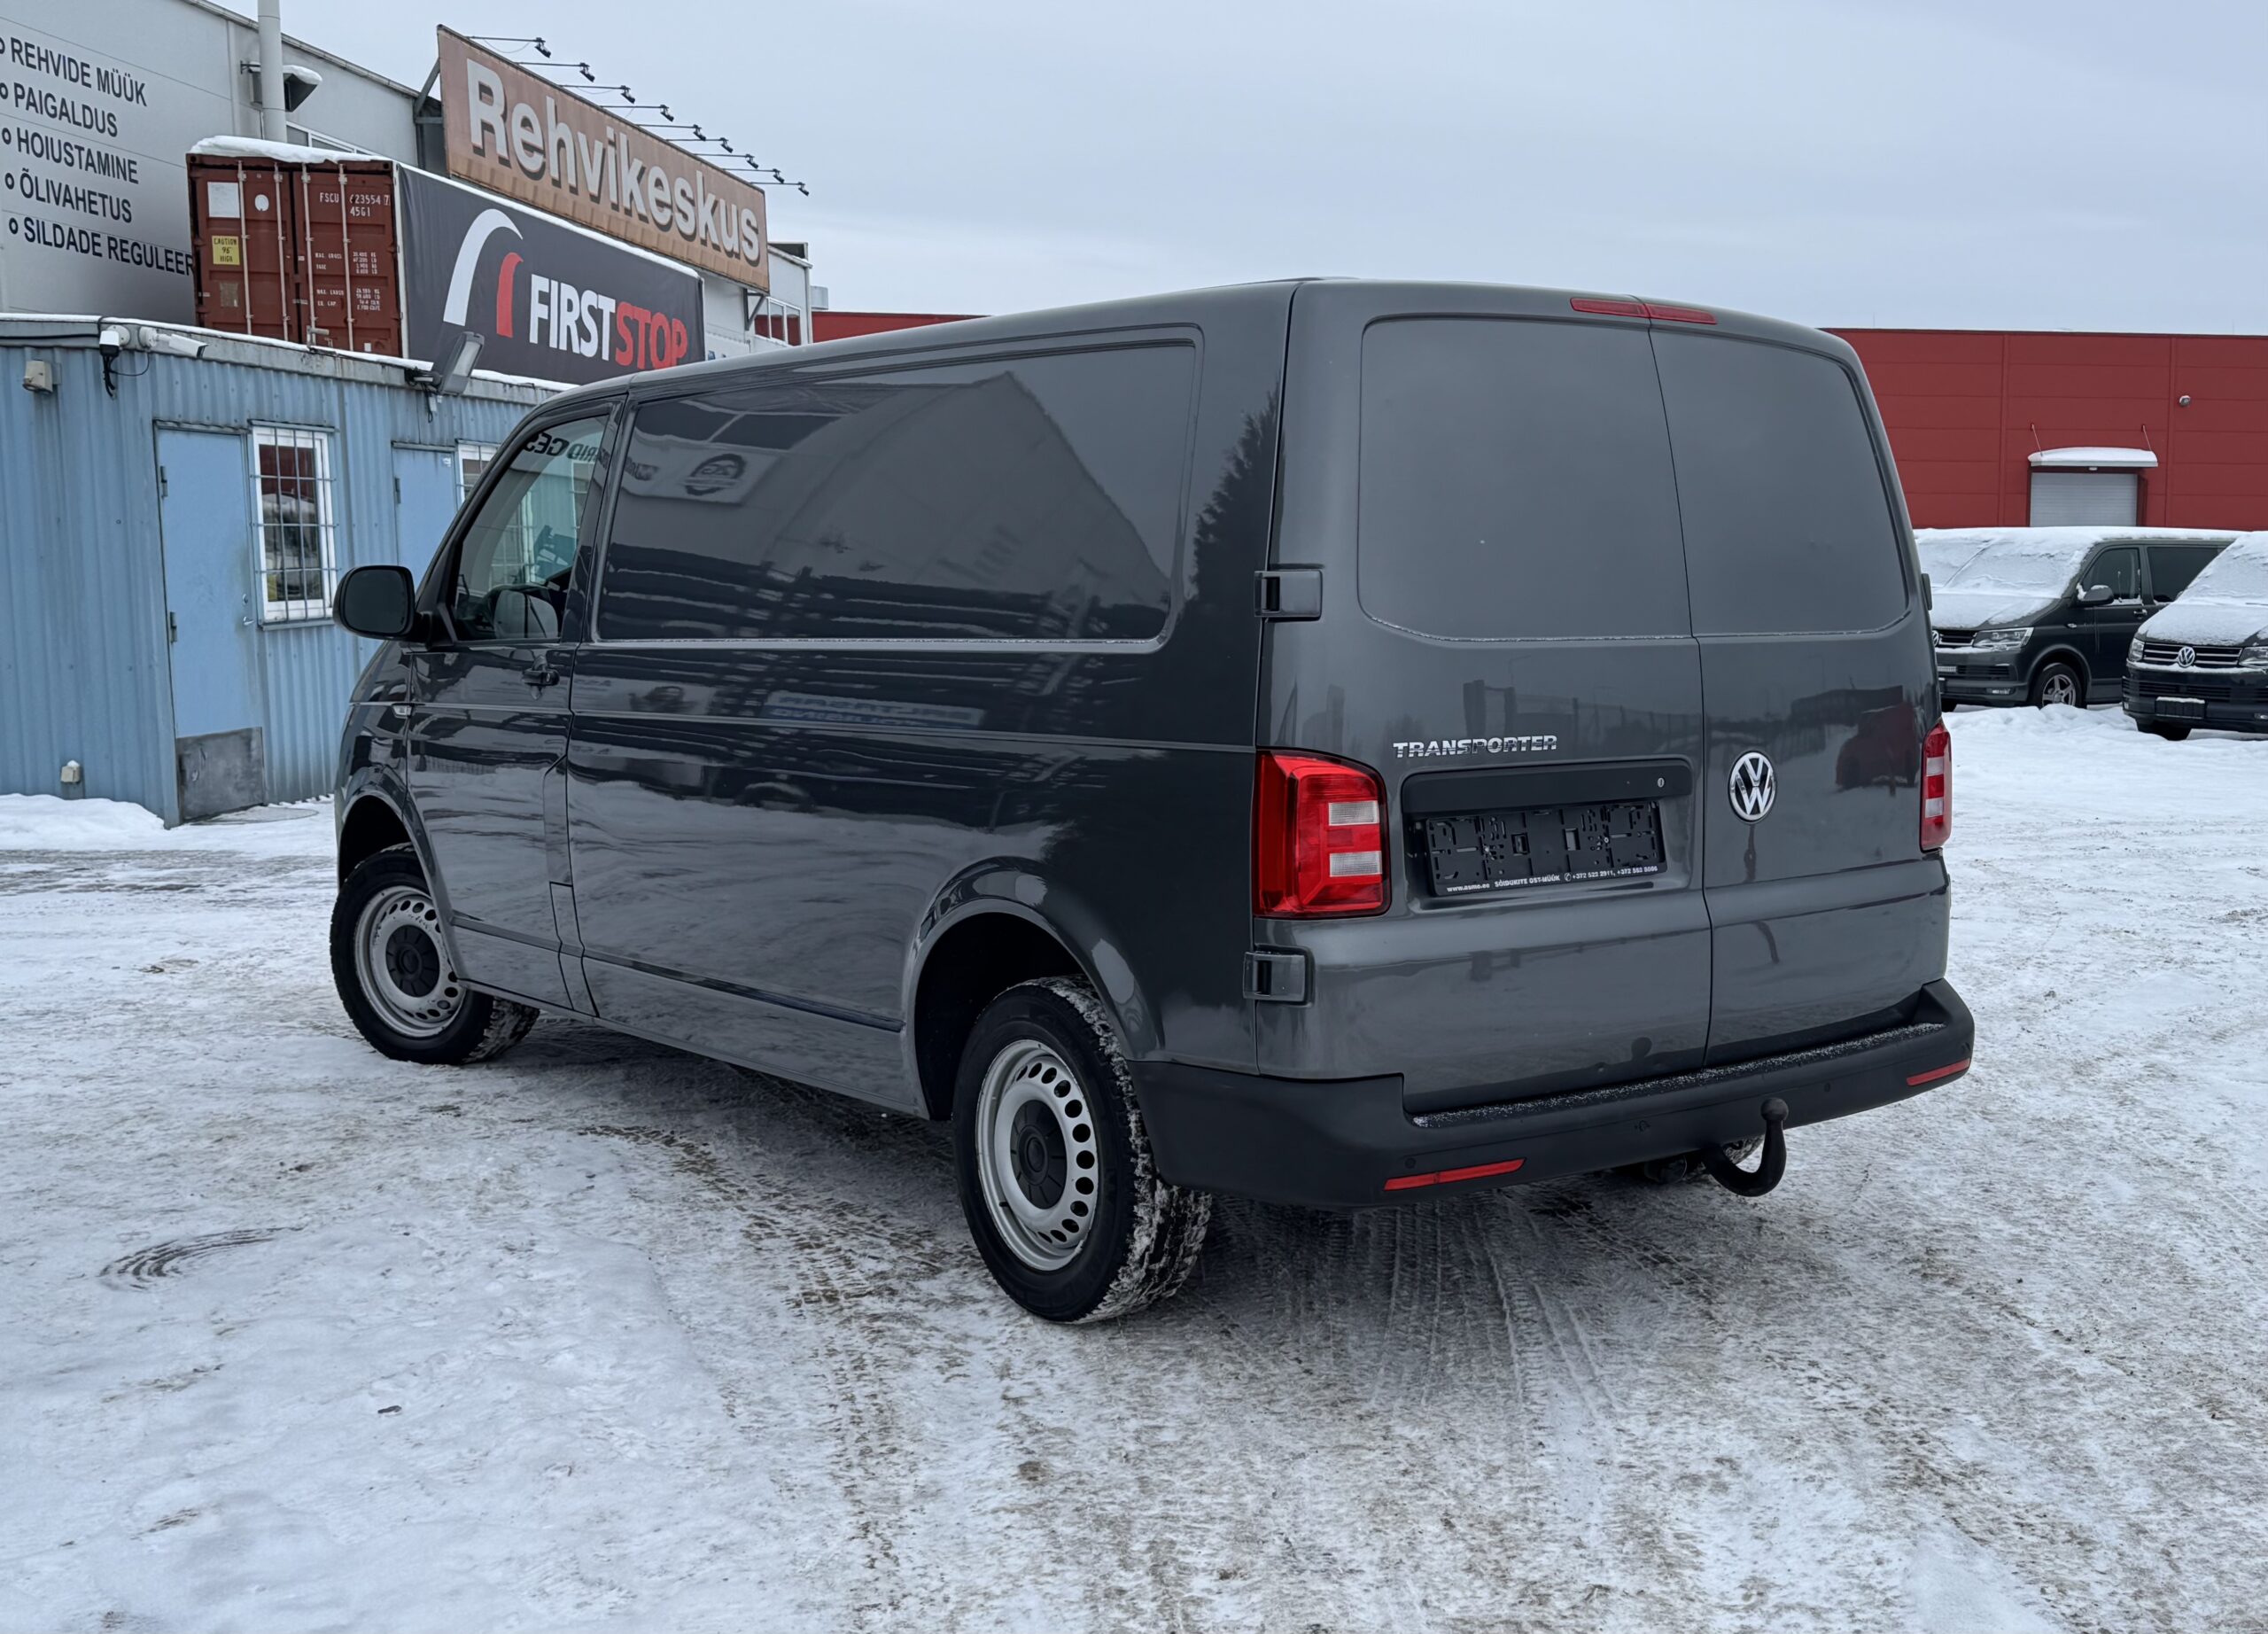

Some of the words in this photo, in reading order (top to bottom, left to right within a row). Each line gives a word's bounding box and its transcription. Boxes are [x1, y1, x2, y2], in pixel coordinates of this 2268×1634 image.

[11, 37, 91, 88] REHVIDE
[97, 67, 147, 106] MÜÜK
[13, 82, 118, 137] PAIGALDUS
[17, 127, 138, 184] HOIUSTAMINE
[466, 58, 760, 264] Rehvikeskus
[19, 167, 132, 223] ÕLIVAHETUS
[319, 192, 339, 203] FSCU
[384, 194, 391, 206] 7
[24, 217, 103, 257] SILDADE
[1393, 735, 1557, 759] TRANSPORTER
